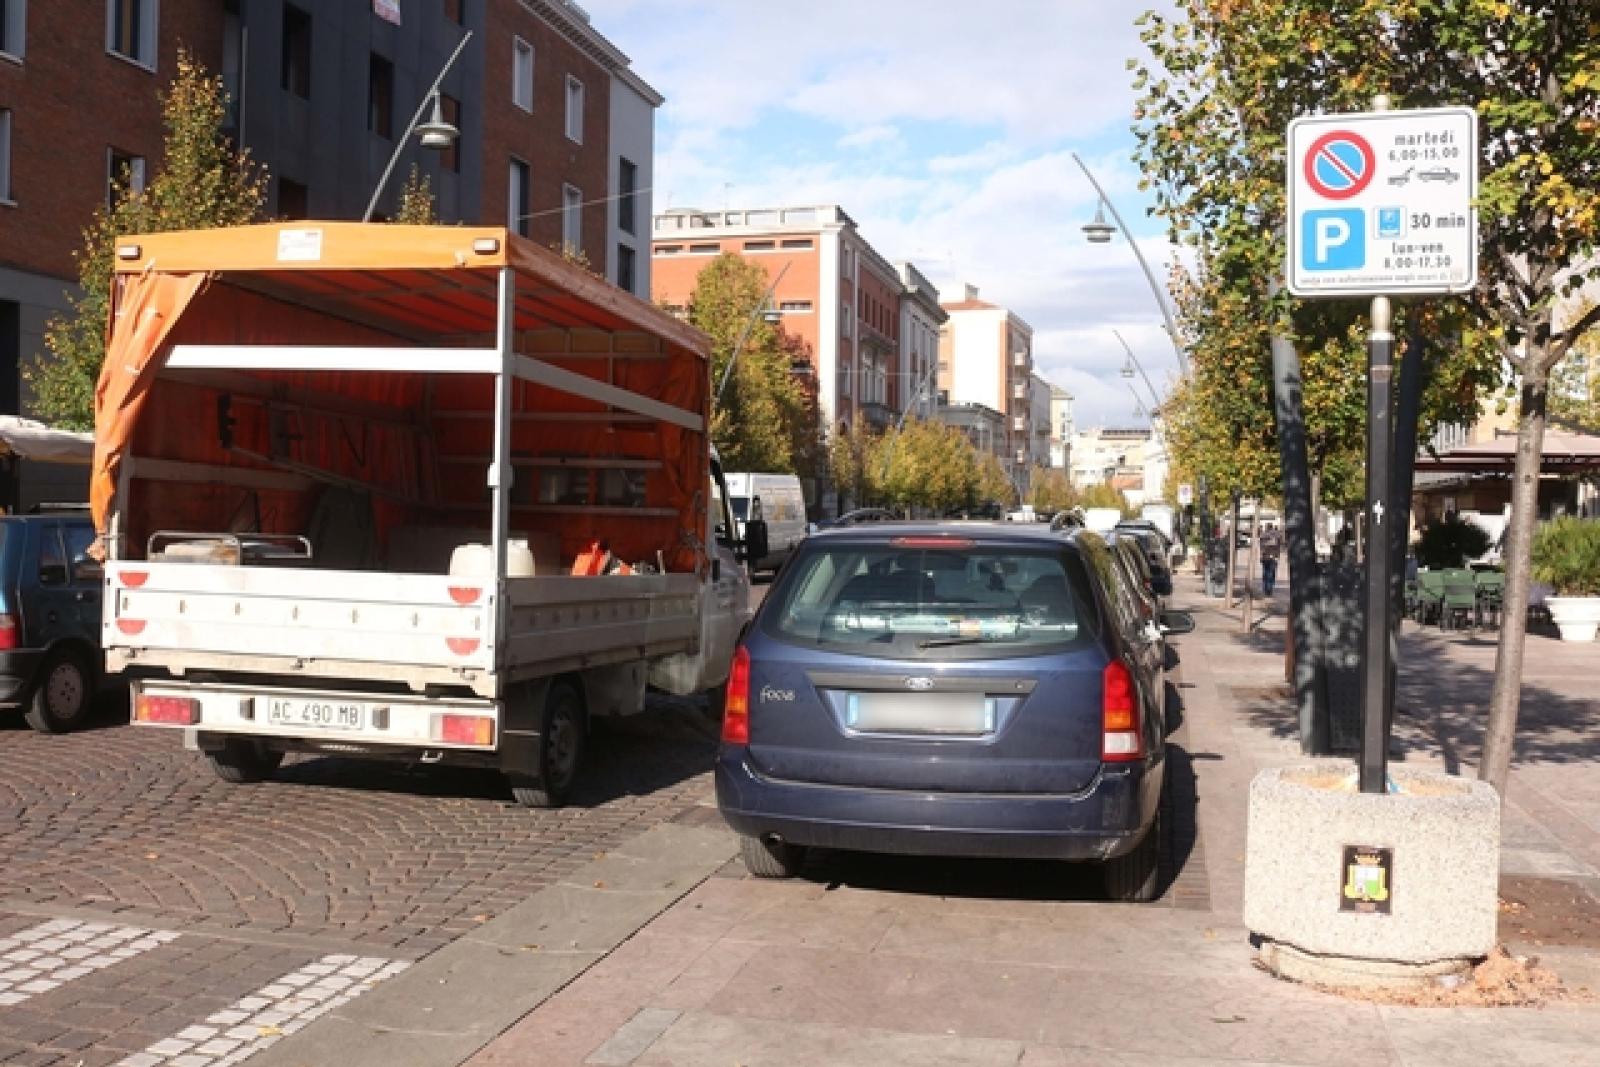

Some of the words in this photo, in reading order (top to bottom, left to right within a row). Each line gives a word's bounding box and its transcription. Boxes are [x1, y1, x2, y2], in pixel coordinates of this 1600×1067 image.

[1410, 212, 1431, 230] 30
[1435, 212, 1466, 229] min
[1316, 217, 1350, 264] P
[272, 702, 291, 719] AC
